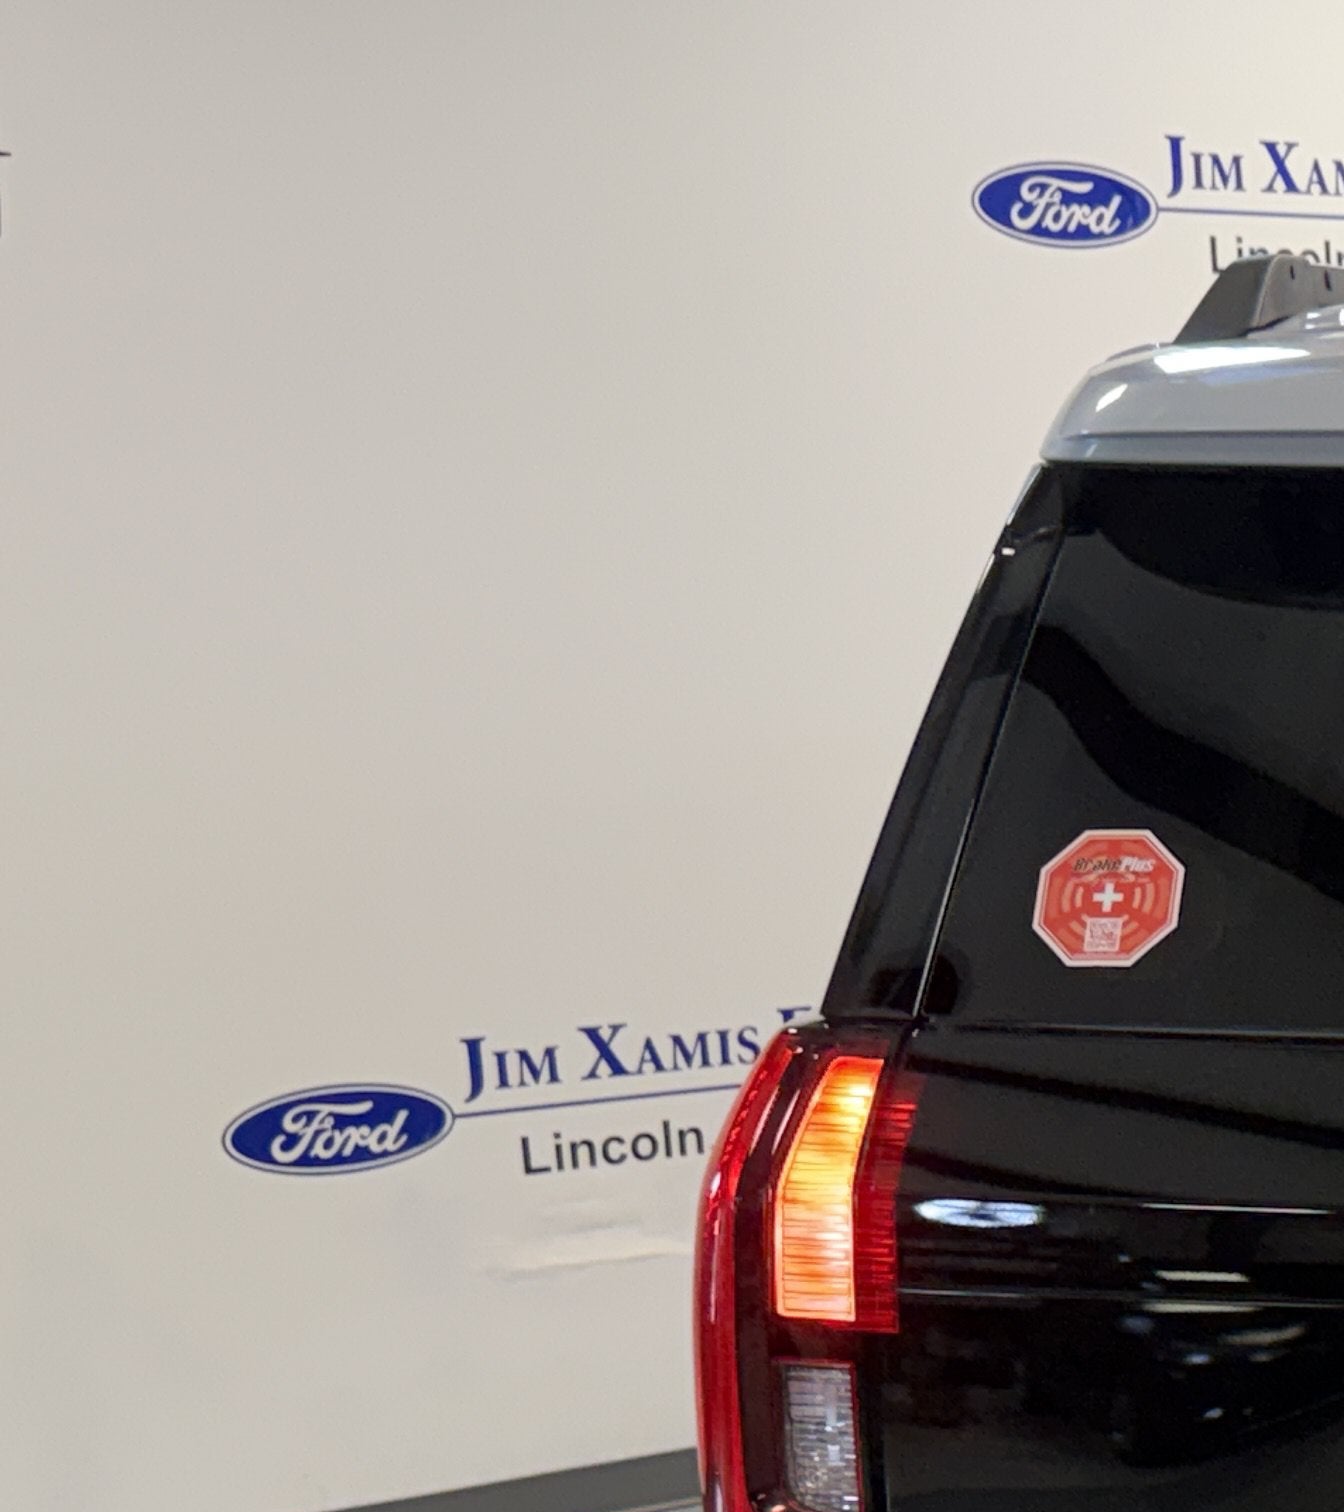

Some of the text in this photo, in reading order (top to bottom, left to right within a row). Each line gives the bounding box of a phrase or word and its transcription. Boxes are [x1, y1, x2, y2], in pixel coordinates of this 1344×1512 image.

[1165, 135, 1244, 198] JIM
[1010, 175, 1121, 236] Ford
[460, 1023, 762, 1104] JIM XAMIS
[271, 1101, 409, 1165] Ford
